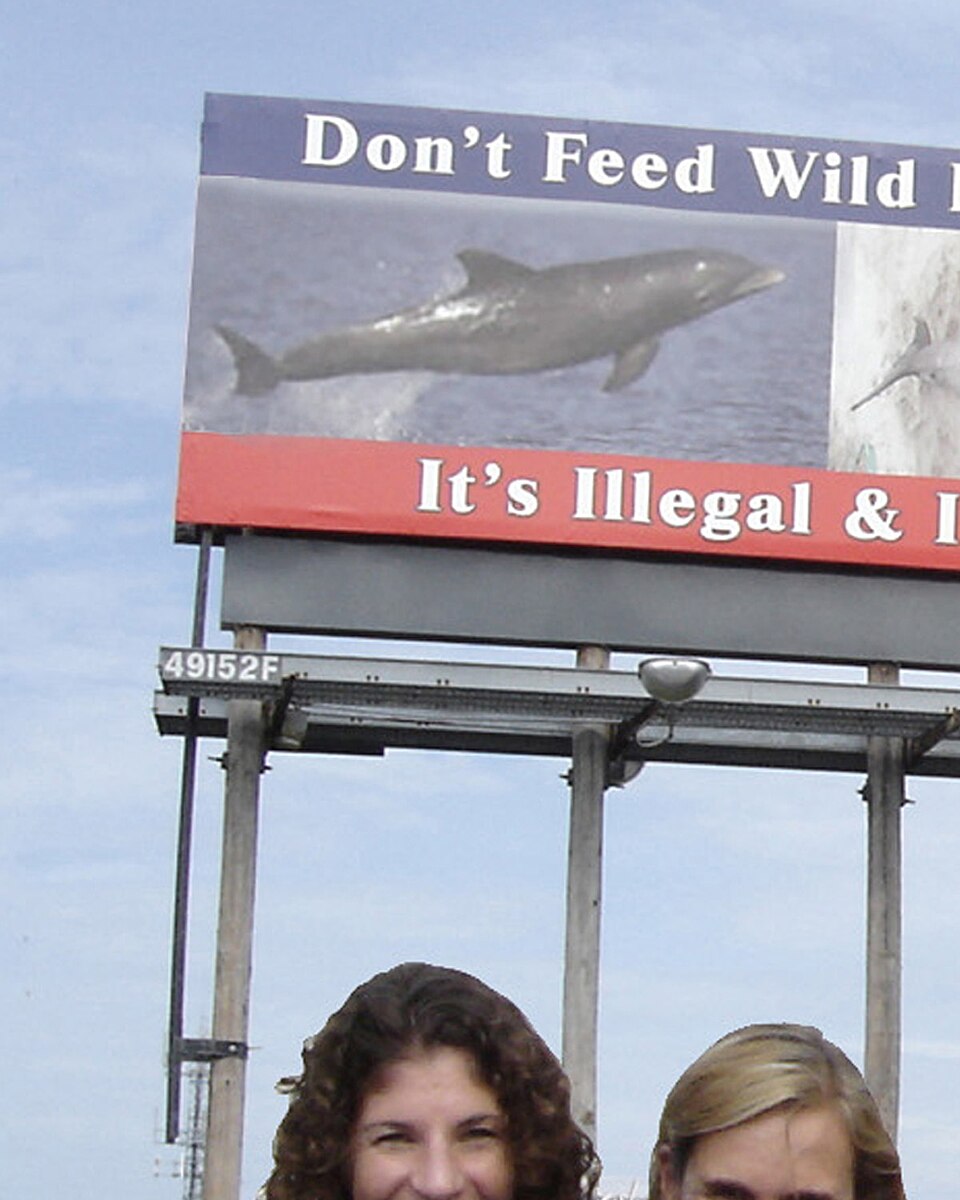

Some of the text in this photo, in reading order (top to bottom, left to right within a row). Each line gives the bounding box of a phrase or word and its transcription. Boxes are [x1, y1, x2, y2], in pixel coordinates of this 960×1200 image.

[302, 113, 512, 178] Don't
[542, 130, 716, 194] Feed
[747, 146, 917, 209] Wild
[416, 458, 539, 518] It's
[572, 465, 812, 541] Illegal
[844, 487, 903, 543] &
[164, 651, 280, 681] 49152F
